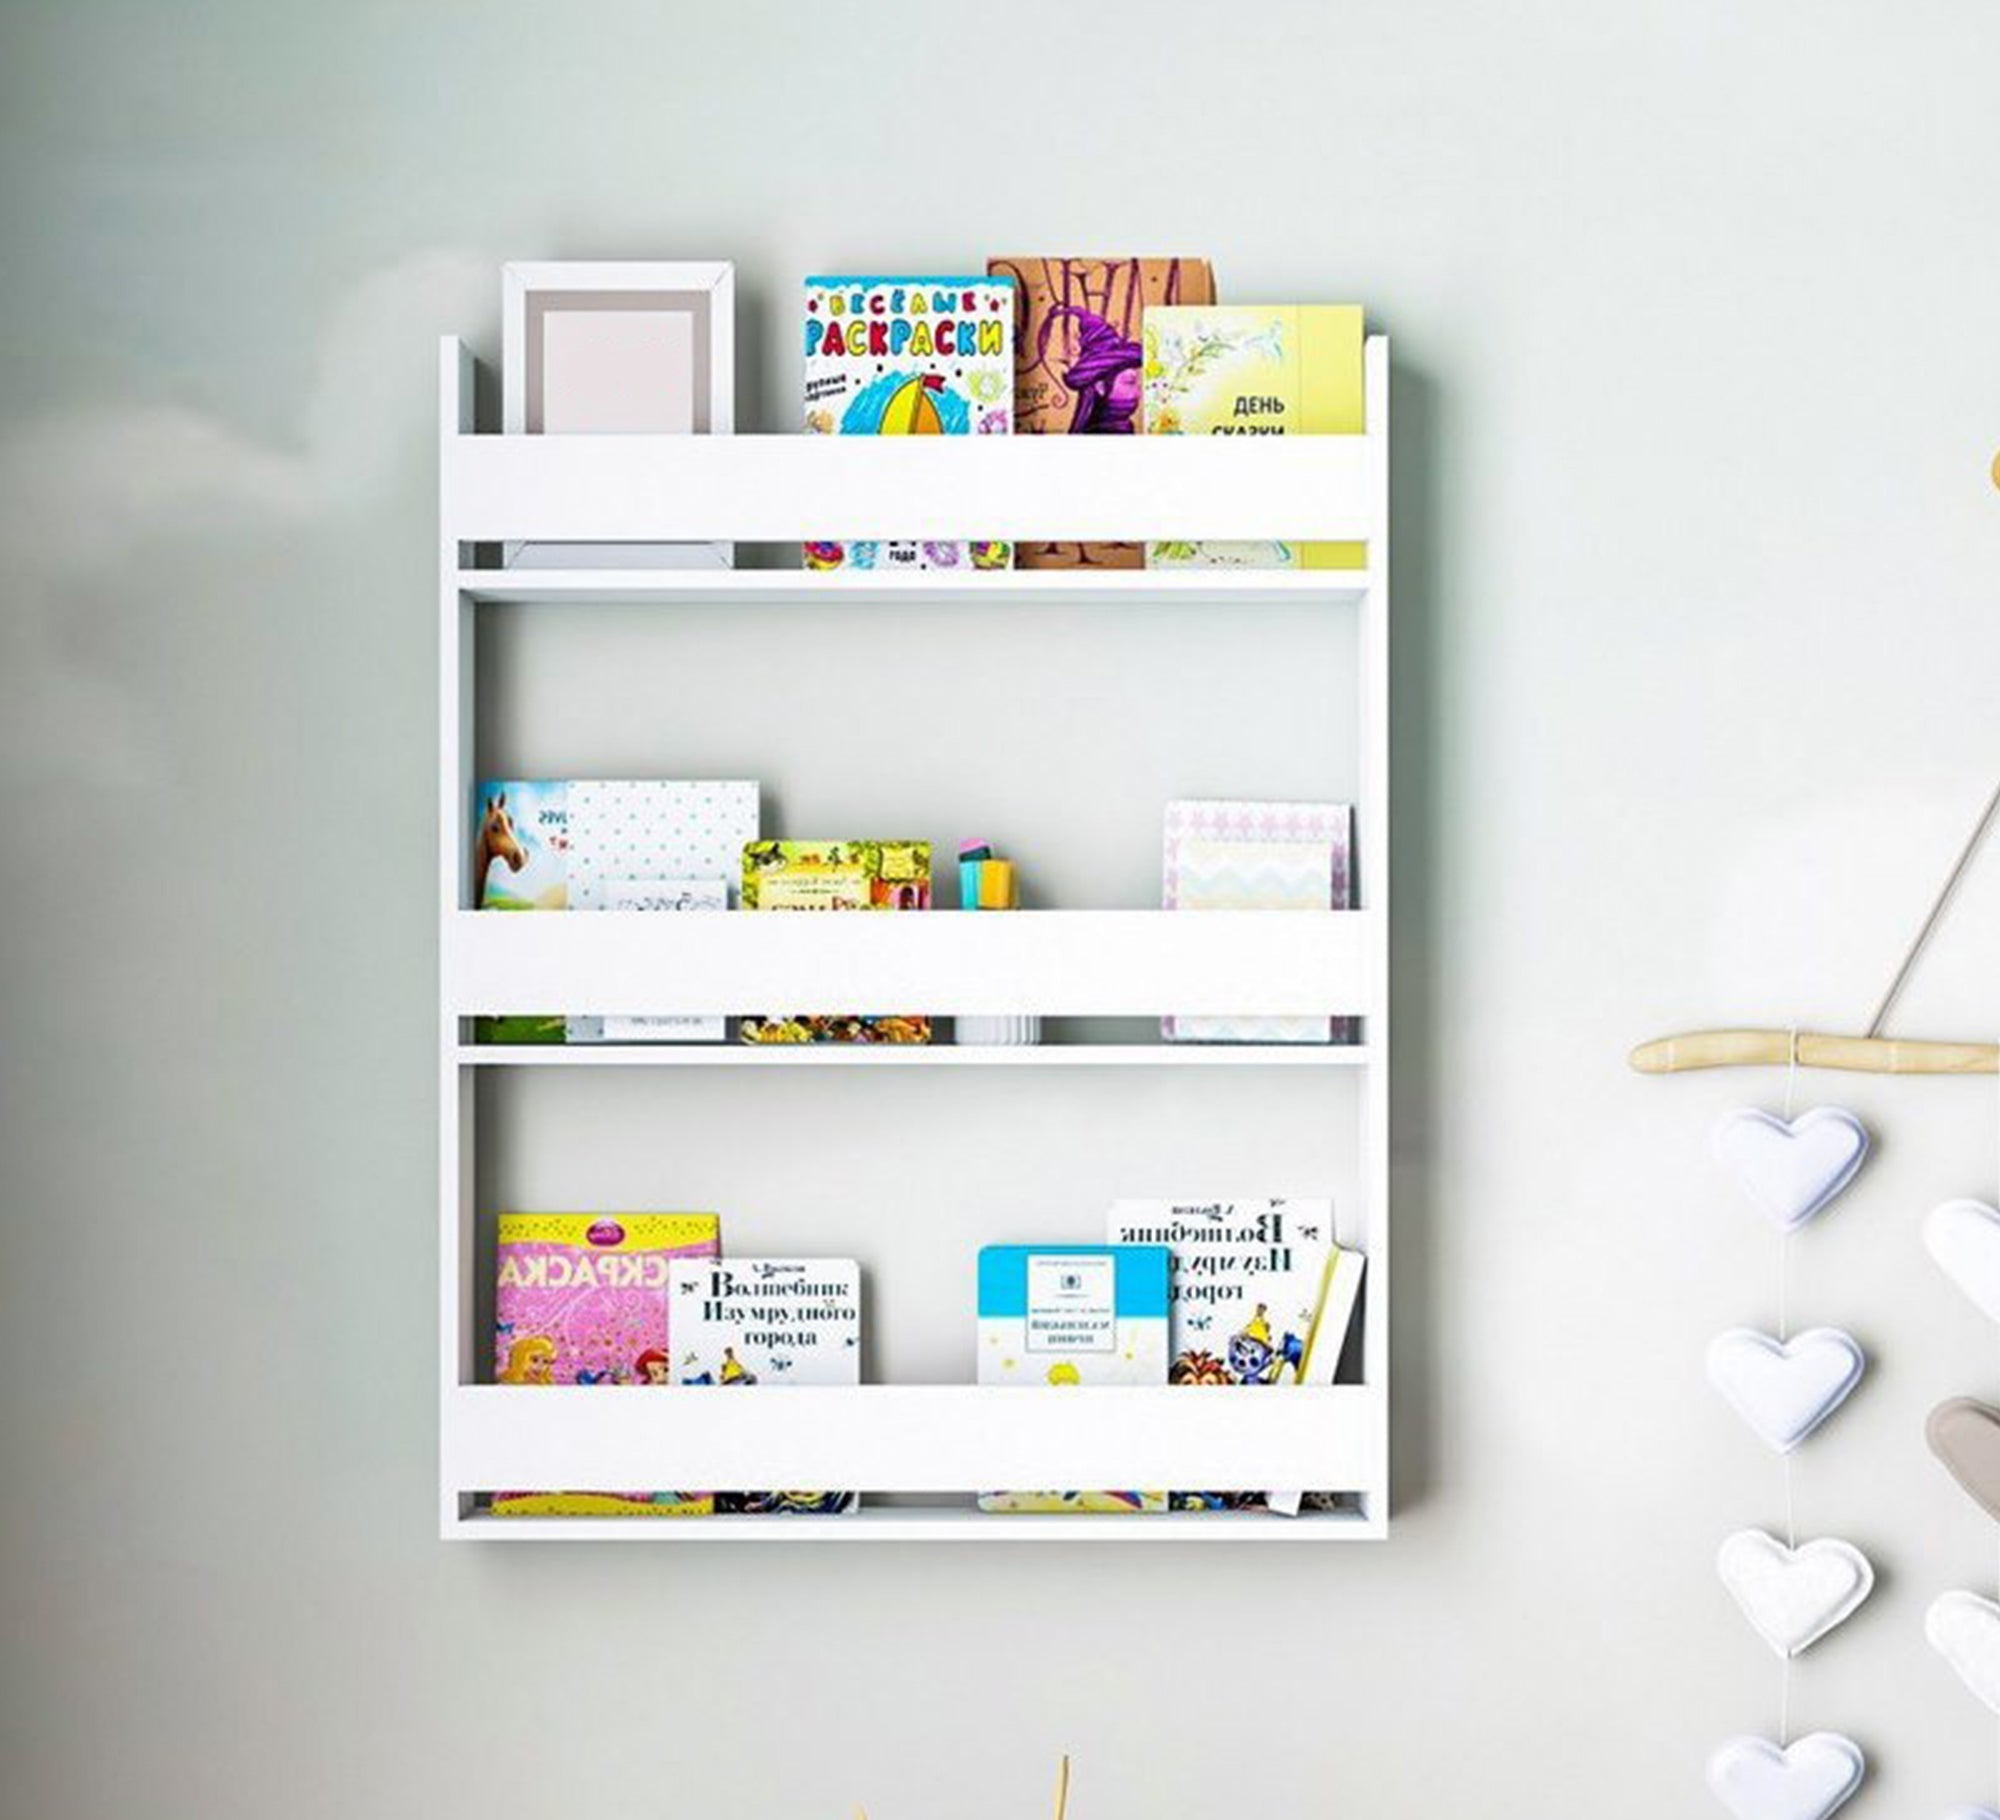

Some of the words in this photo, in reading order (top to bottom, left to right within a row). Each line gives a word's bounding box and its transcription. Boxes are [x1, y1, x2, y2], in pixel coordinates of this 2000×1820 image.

[828, 288, 977, 317] ВЕСЁЛЫЕ
[804, 318, 1003, 357] РАСКРАСКИ
[1233, 395, 1285, 416] ДЕНЬ
[711, 1271, 849, 1298] Волшебник
[703, 1301, 857, 1324] Изумрудного
[744, 1331, 817, 1349] города
